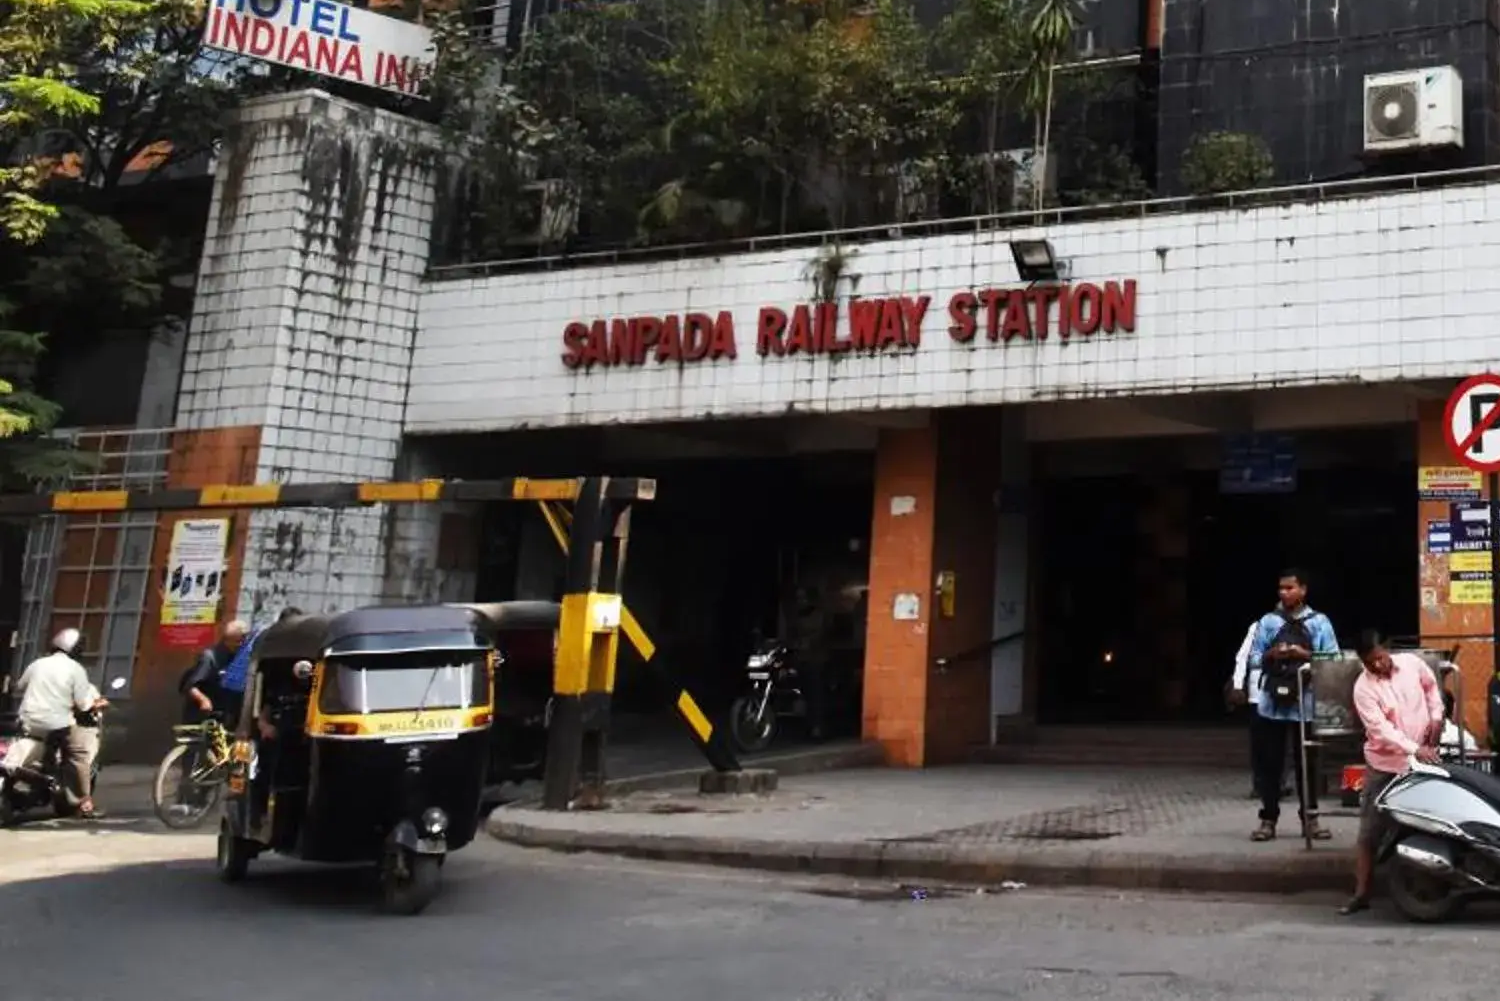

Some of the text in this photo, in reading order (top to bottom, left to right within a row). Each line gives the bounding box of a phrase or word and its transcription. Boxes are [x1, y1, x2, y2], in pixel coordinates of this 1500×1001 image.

[210, 8, 364, 82] INDIANA
[561, 279, 1137, 369] SANPADA RAILWAY STATION
